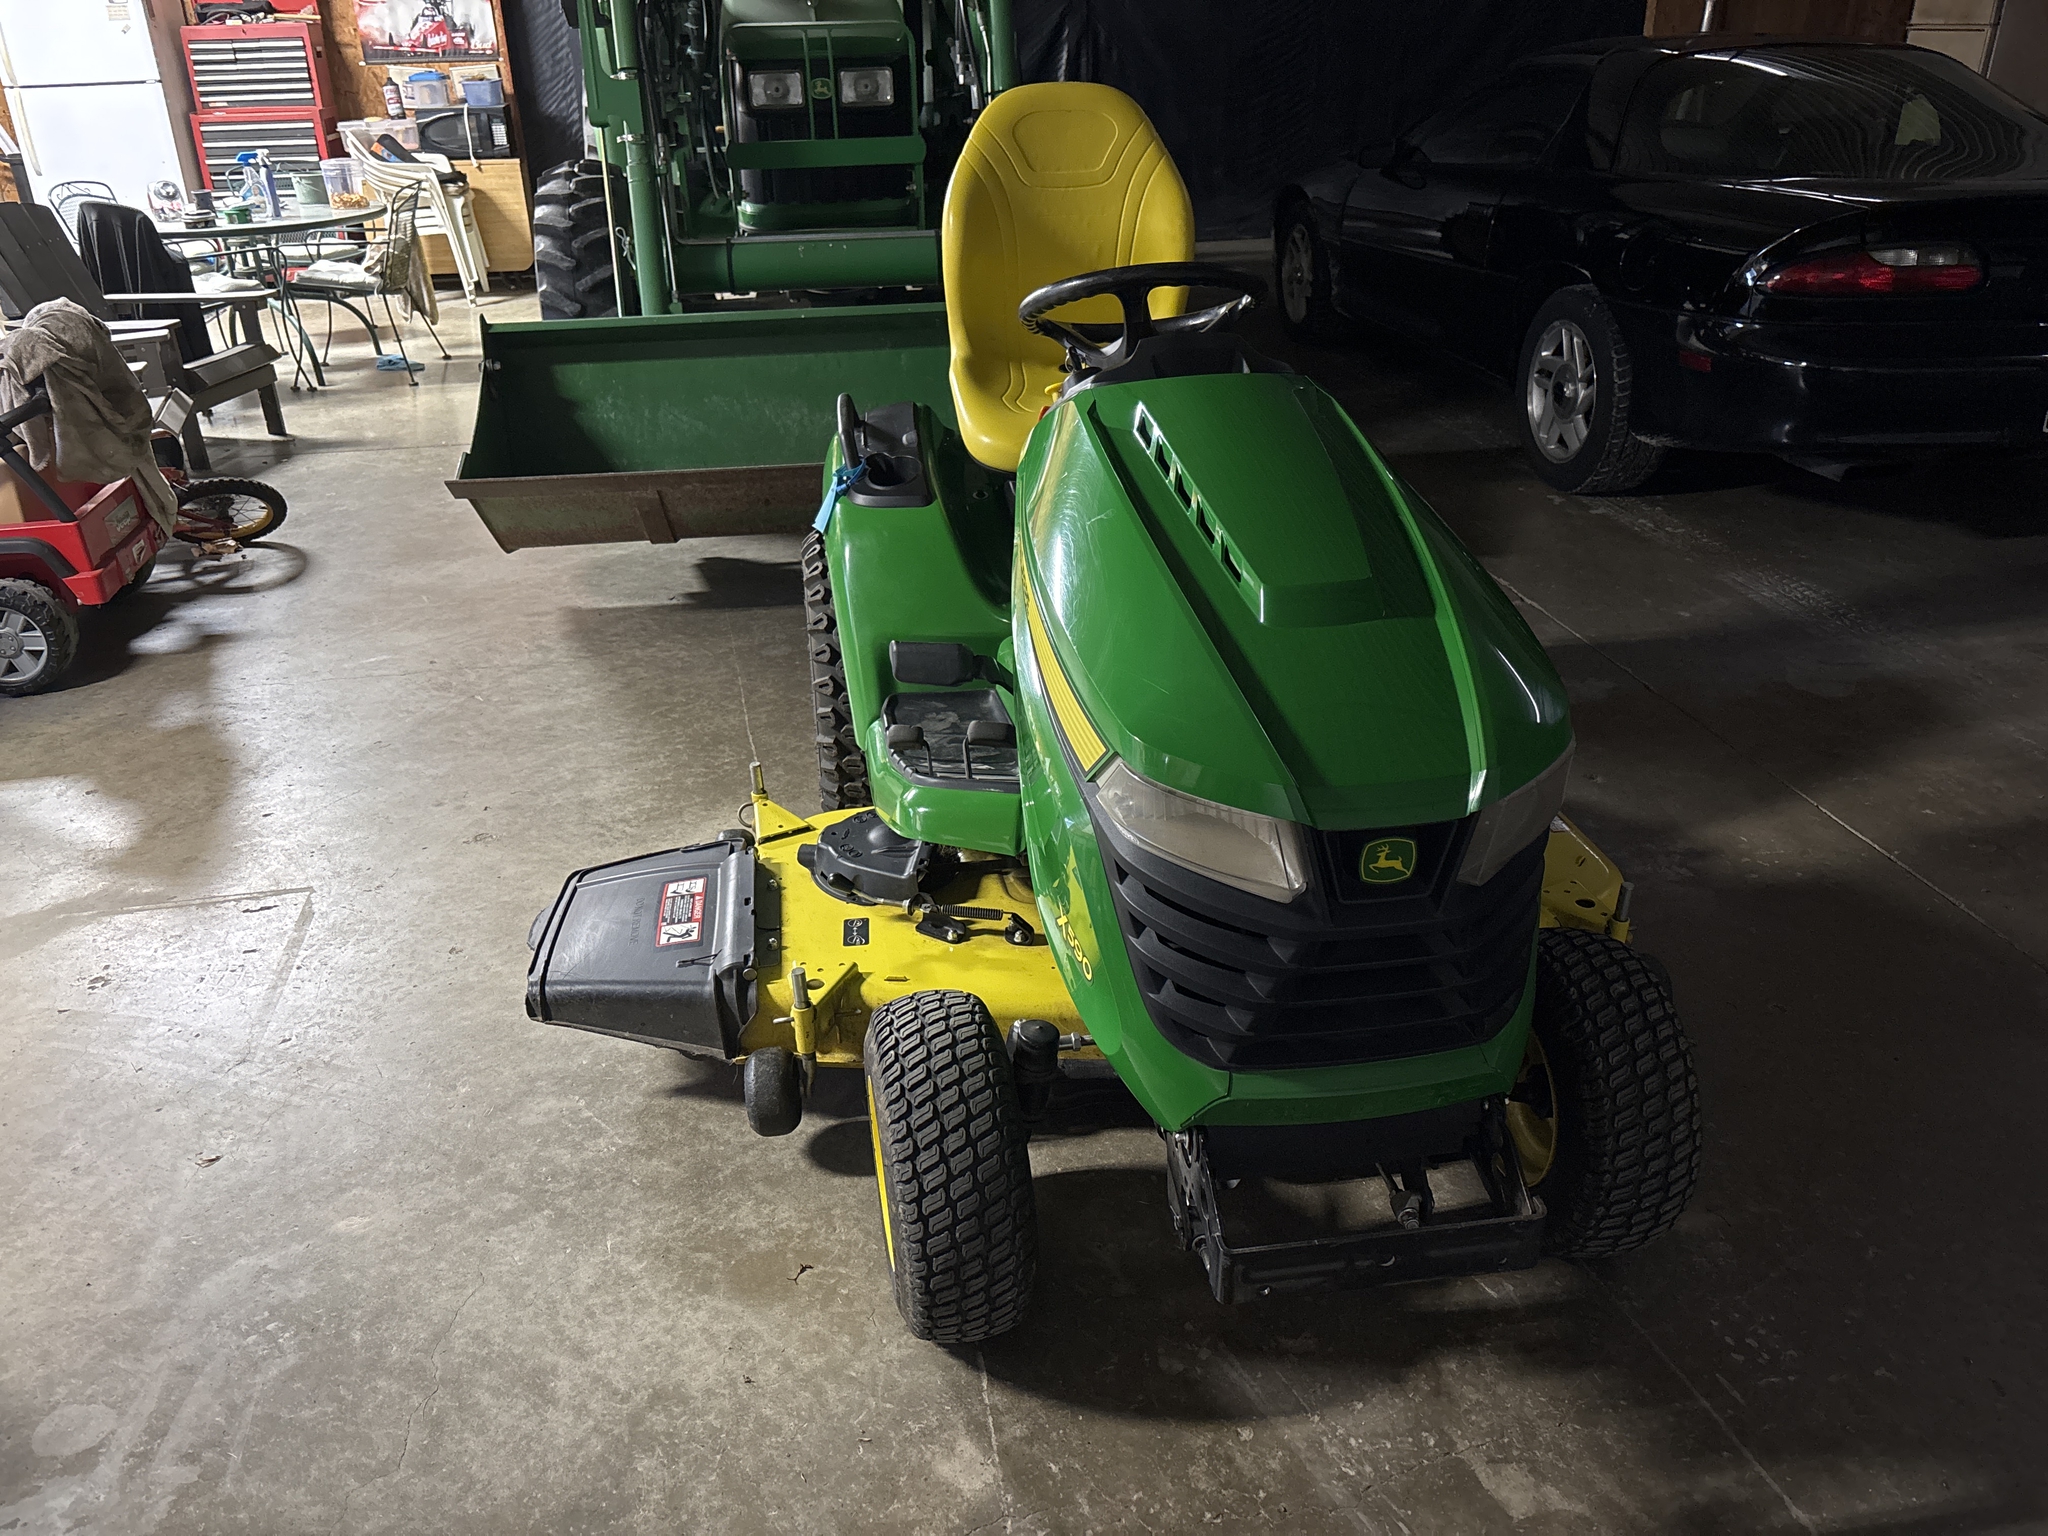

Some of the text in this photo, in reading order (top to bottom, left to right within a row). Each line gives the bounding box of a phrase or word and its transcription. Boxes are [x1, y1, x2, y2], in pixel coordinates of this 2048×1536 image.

[469, 38, 492, 49] Bud
[693, 900, 703, 919] DANGER
[1057, 898, 1093, 981] X590
